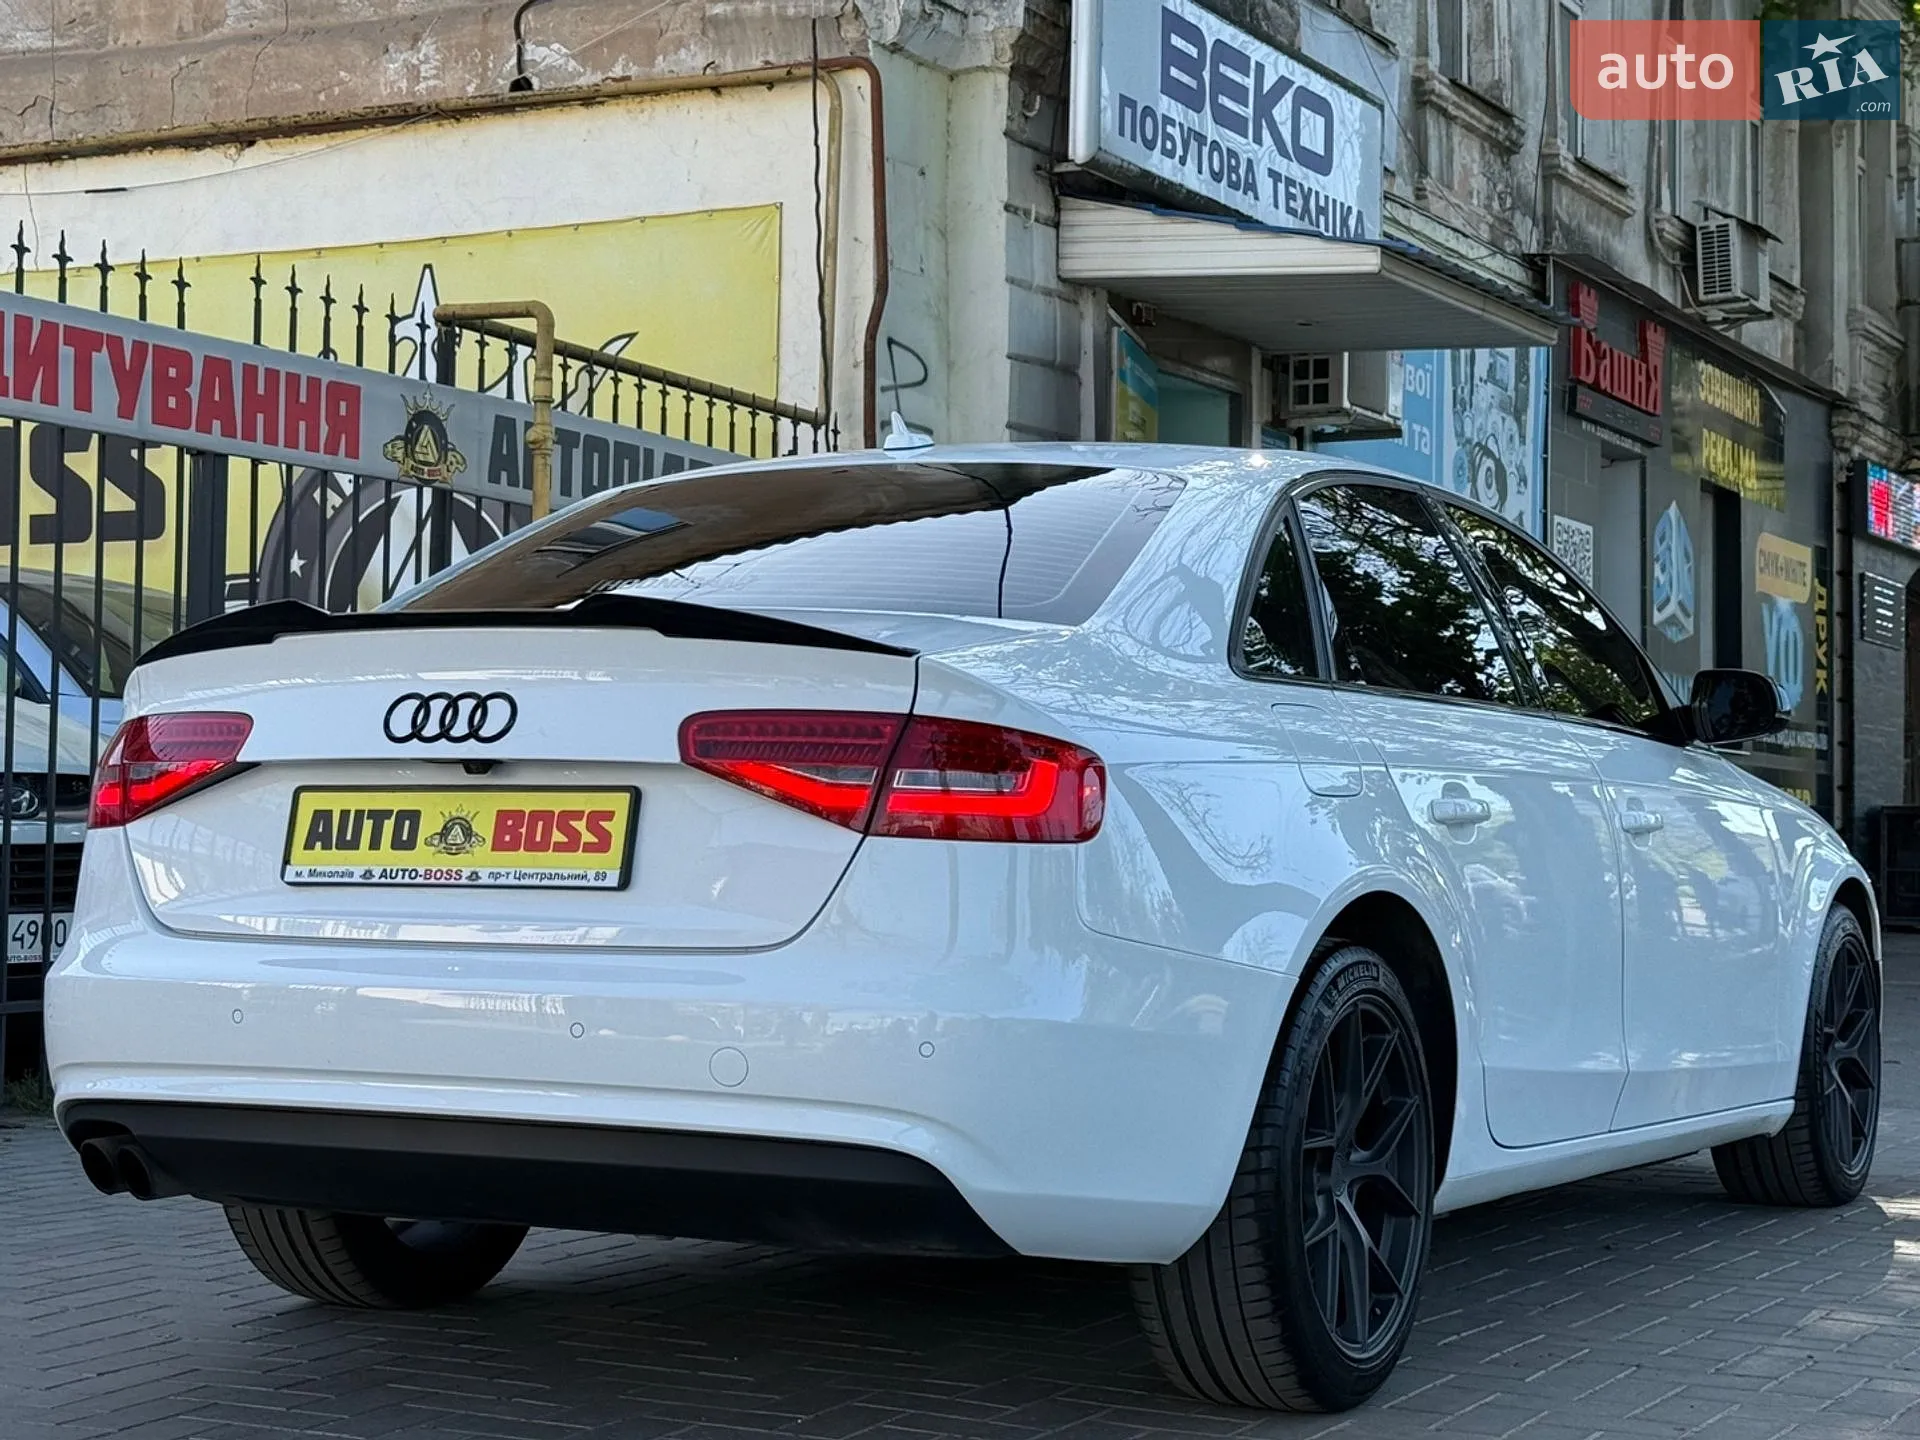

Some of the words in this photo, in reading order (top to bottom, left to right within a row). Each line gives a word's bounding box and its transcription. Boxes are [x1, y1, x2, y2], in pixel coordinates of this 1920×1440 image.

[1159, 4, 1335, 177] BEKO
[1118, 93, 1260, 201] ПОБУТОВА
[1267, 168, 1367, 238] ТЕХНІКА
[1570, 315, 1664, 417] Башня
[1412, 422, 1431, 456] та
[1814, 577, 1828, 696] ДРУК
[303, 809, 422, 851] AUTO
[490, 809, 616, 854] BOSS
[378, 868, 463, 882] AUTO-BOSS
[487, 870, 511, 882] пр-т
[513, 869, 591, 883] Центральний,
[593, 870, 608, 882] 89
